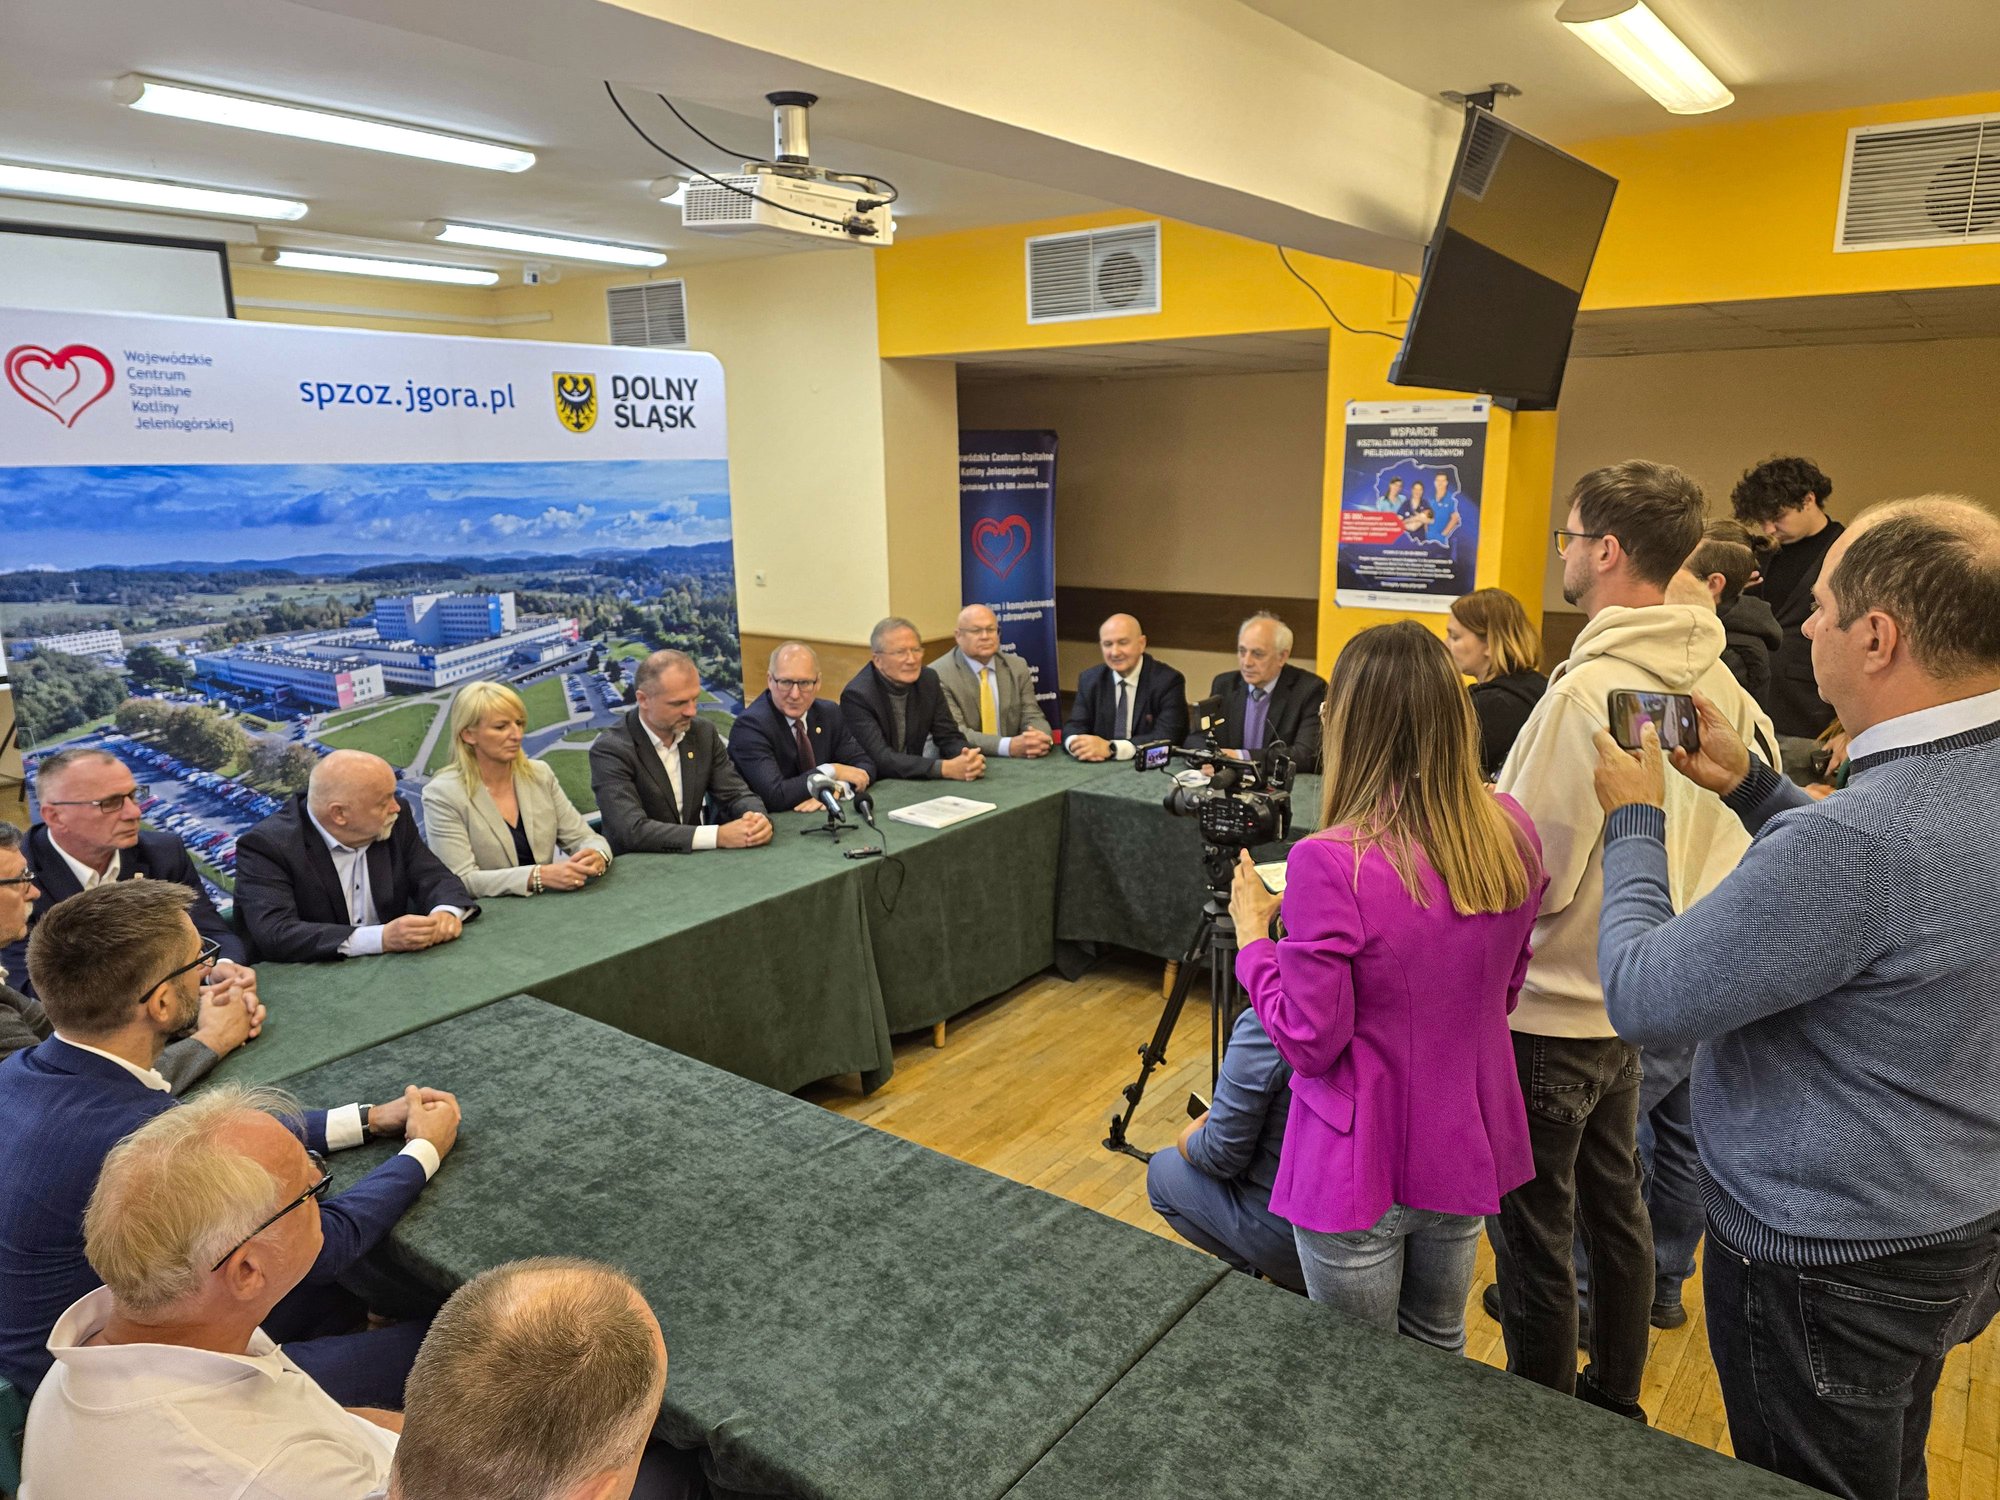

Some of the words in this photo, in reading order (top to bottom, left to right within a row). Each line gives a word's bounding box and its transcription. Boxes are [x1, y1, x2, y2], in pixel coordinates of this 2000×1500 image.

[123, 350, 213, 366] Wojewódzkie
[127, 366, 186, 380] Centrum
[129, 383, 192, 398] Szpitalne
[612, 375, 698, 401] DOLNY
[299, 379, 515, 414] spzoz.jgora.pl
[132, 400, 179, 415] Kotliny
[614, 396, 696, 432] ŚLĄSK
[136, 417, 234, 433] Jeleniogórskiej
[1390, 426, 1439, 437] WSPARCIE
[991, 452, 1021, 462] Centrum
[1022, 452, 1054, 462] Szpitalne
